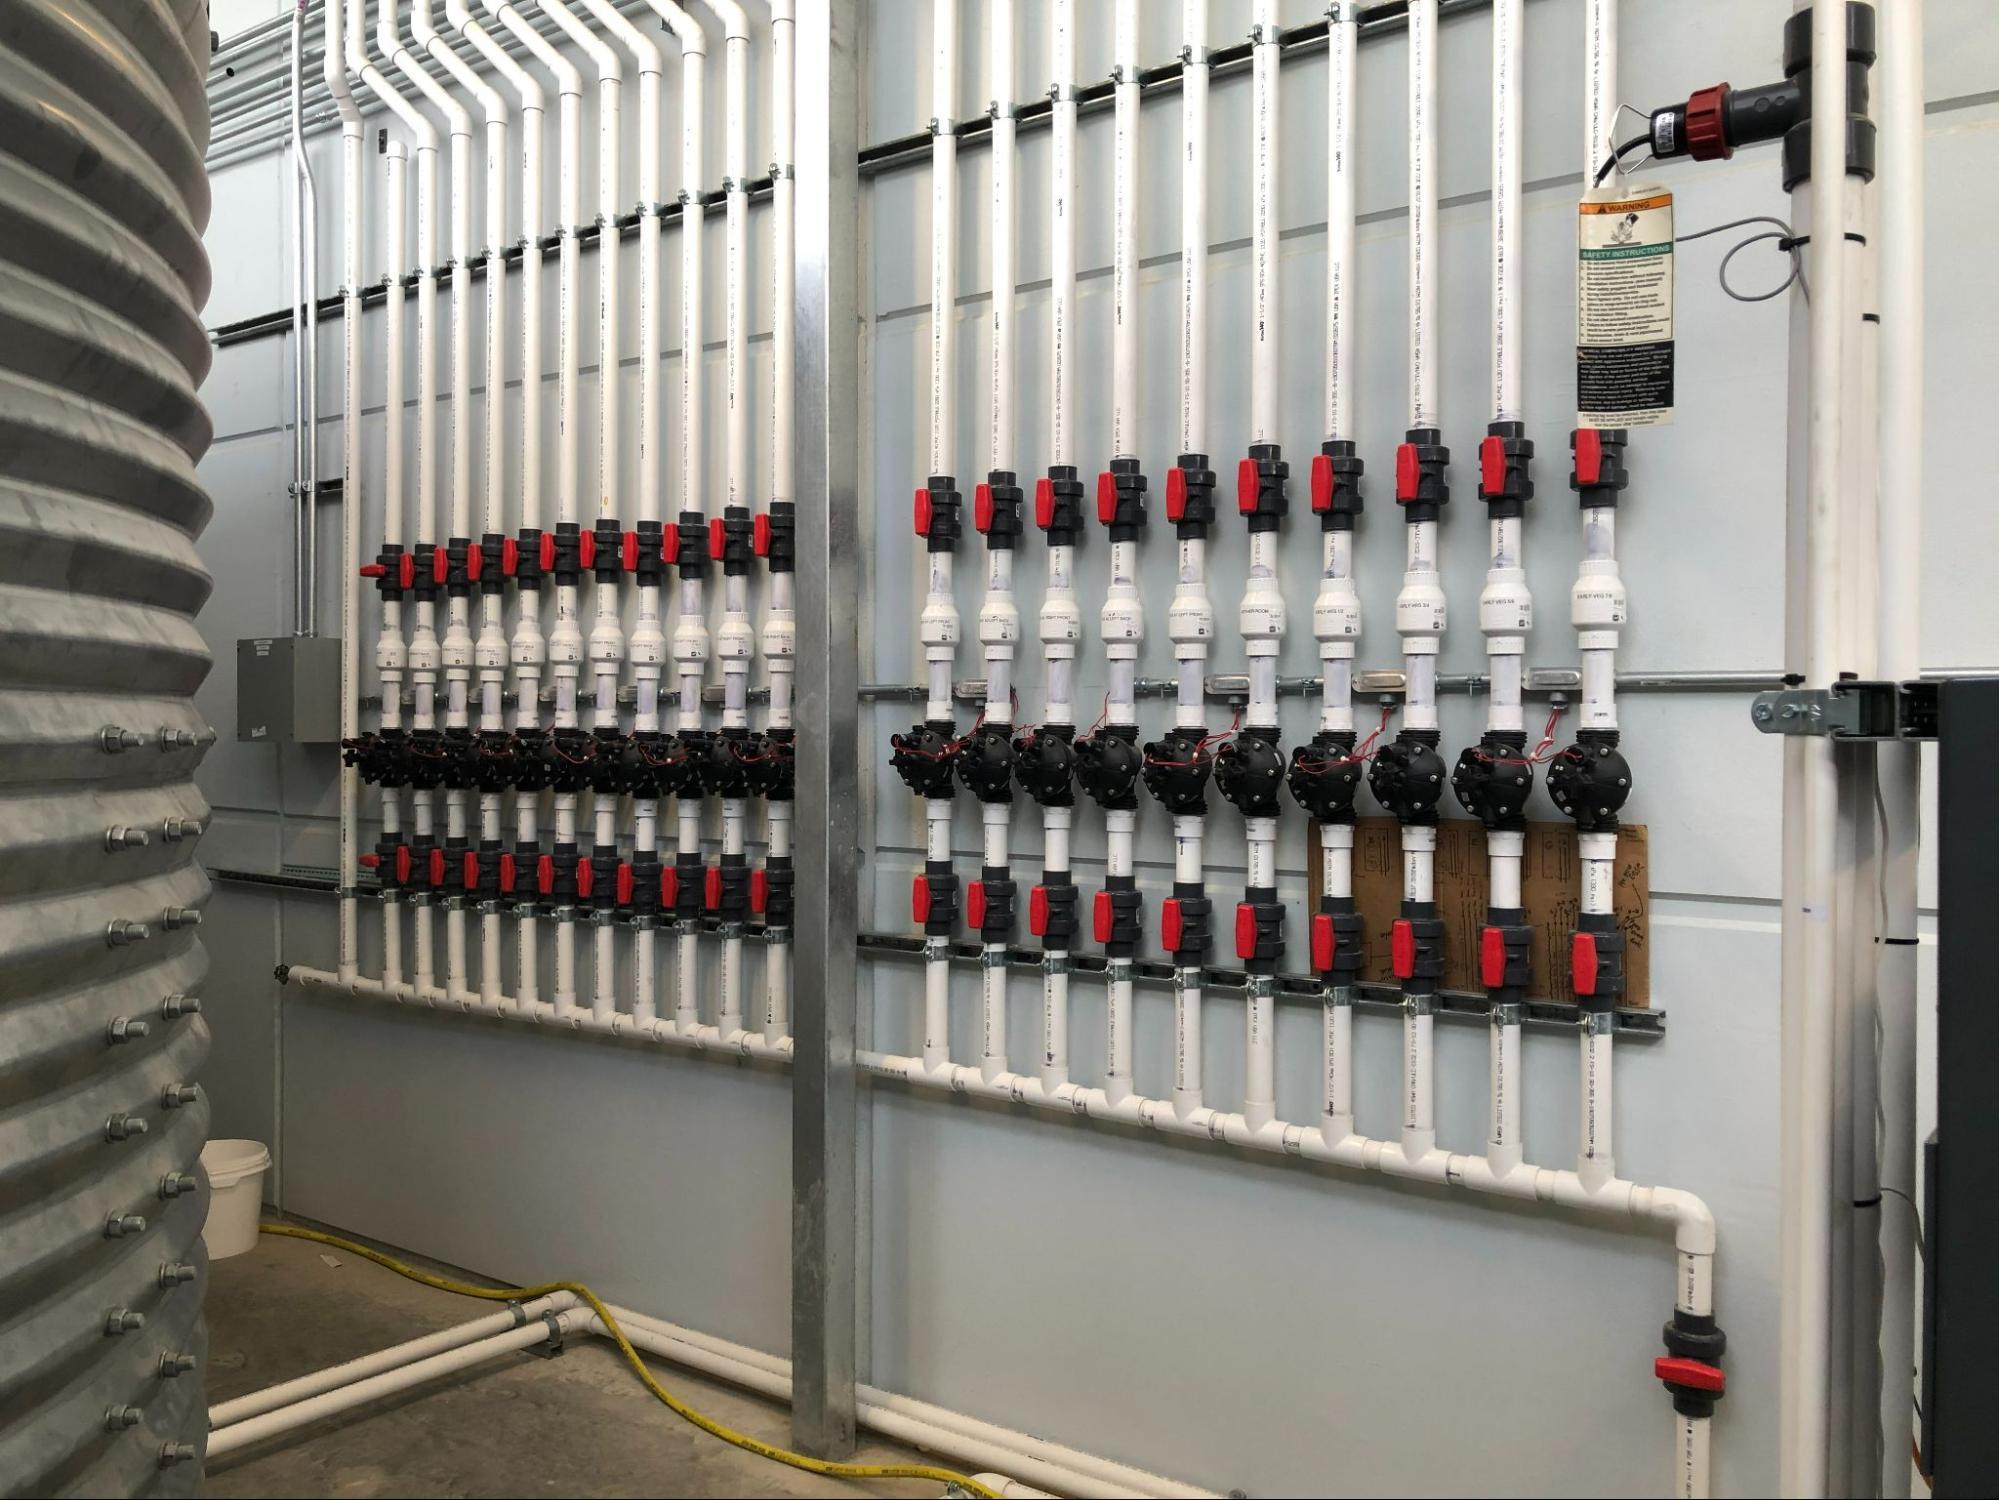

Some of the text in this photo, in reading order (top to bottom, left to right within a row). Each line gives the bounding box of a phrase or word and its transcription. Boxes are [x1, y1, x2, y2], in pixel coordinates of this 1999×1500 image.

[1607, 201, 1650, 212] WARNING
[1582, 244, 1671, 259] SAFETY INSTRUCTIONS
